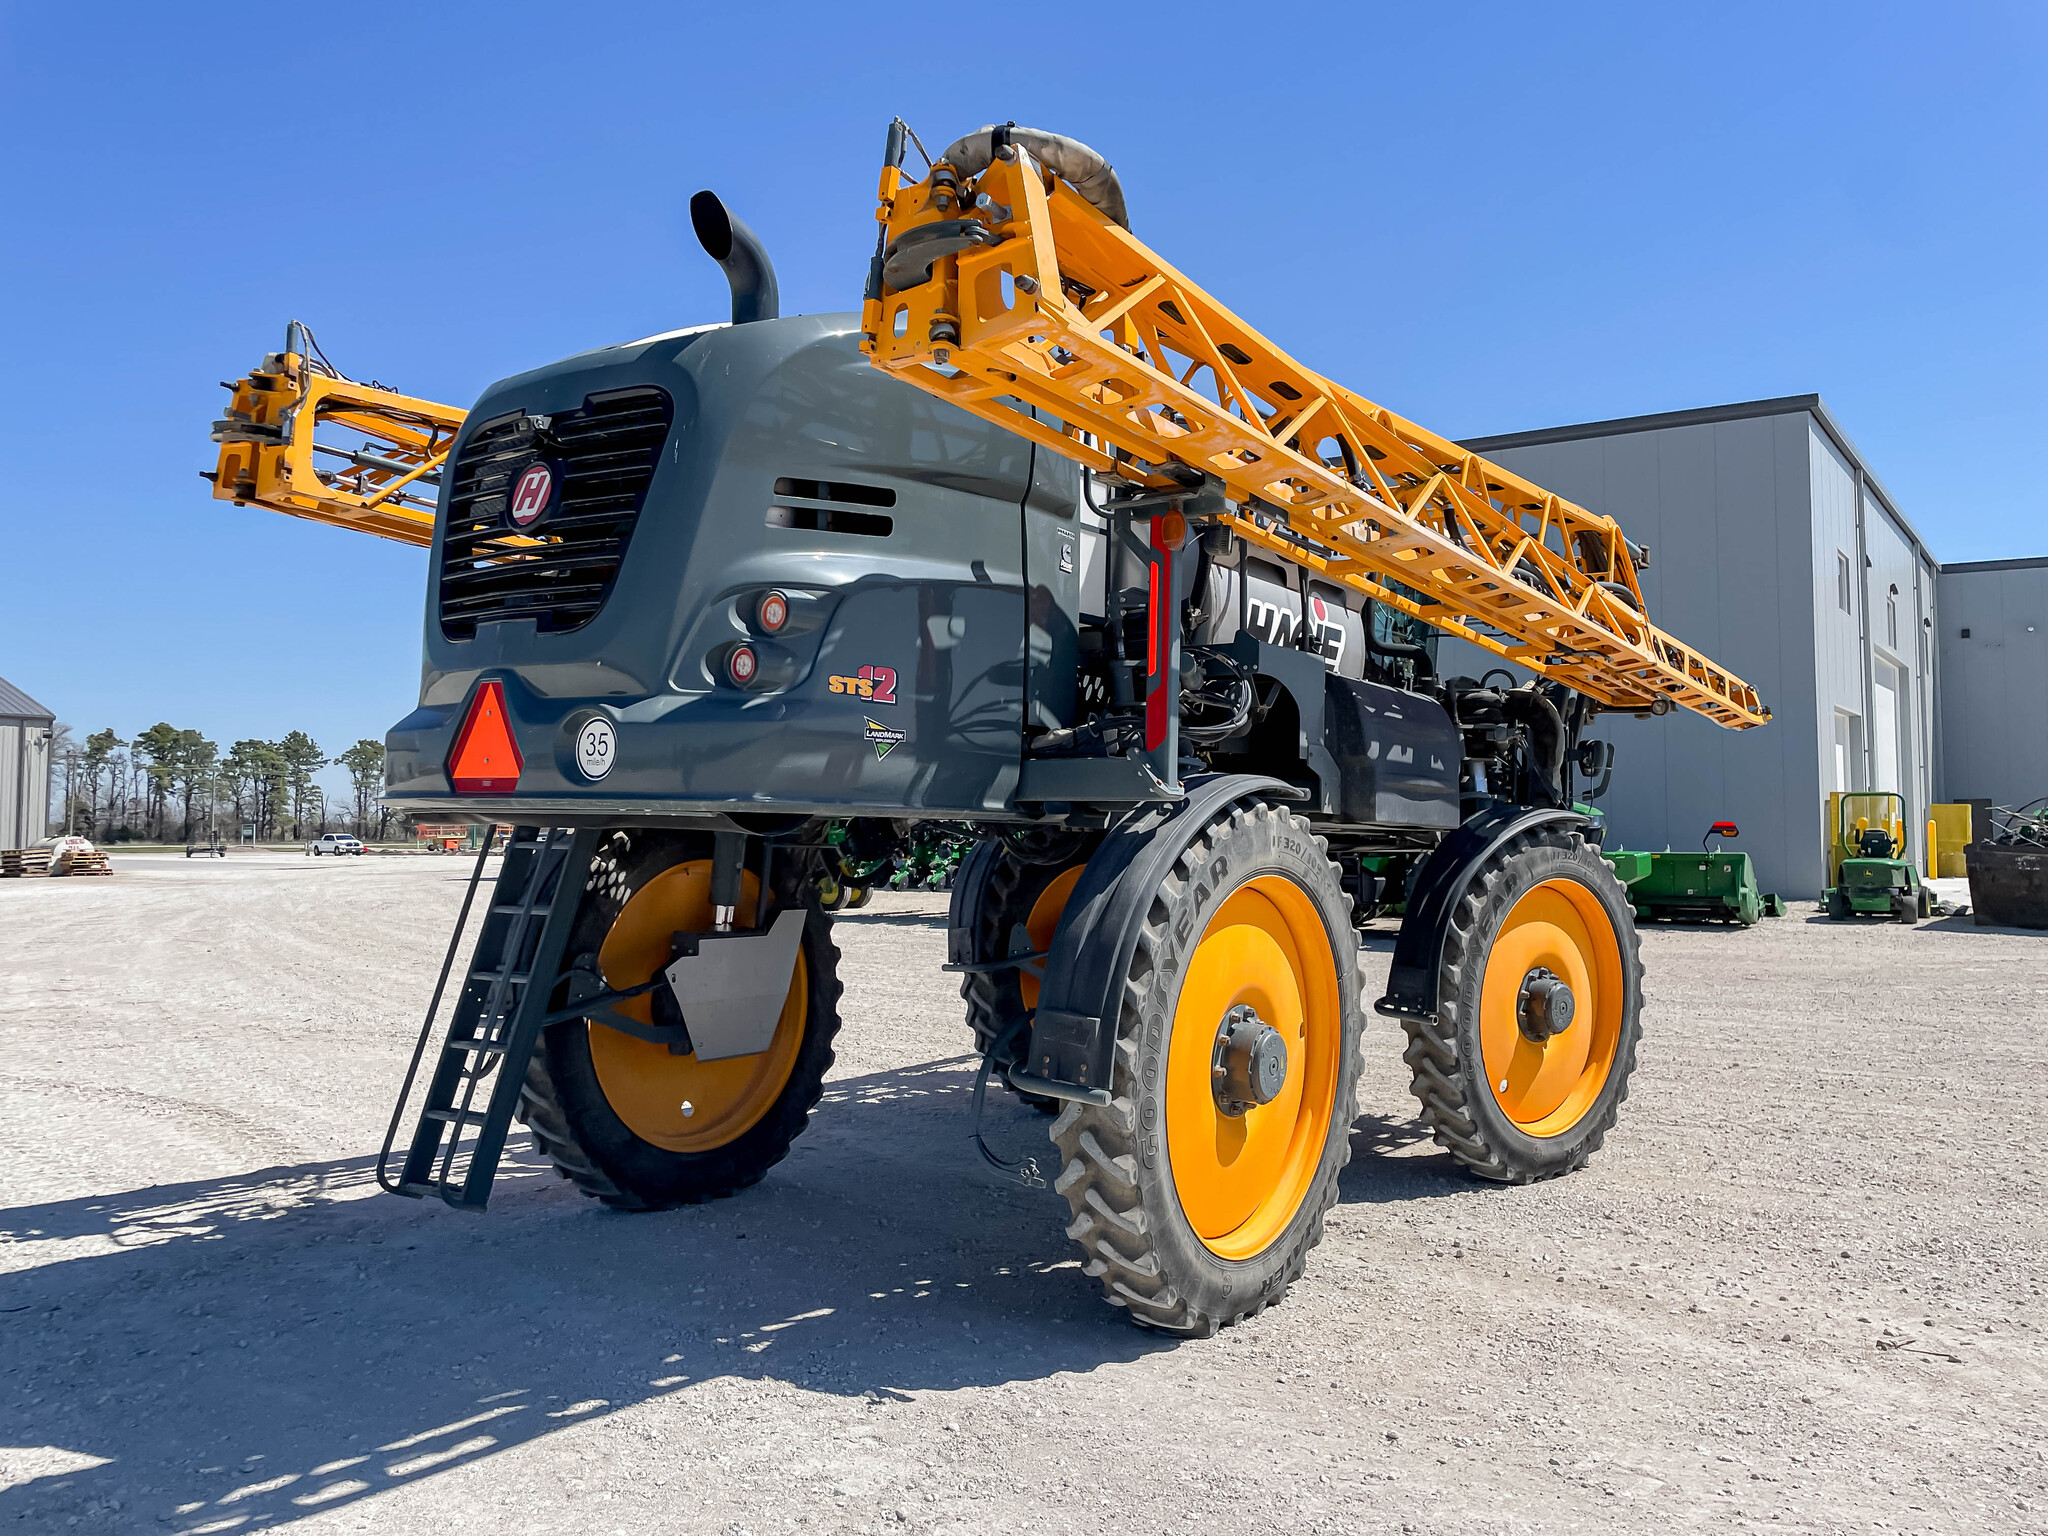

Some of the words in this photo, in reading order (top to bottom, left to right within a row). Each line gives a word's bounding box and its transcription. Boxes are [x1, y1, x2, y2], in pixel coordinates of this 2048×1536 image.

[586, 732, 609, 757] 35
[586, 758, 606, 766] mile/h
[1141, 854, 1229, 1169] GOODYEAR
[1460, 872, 1518, 1081] GOODYEAR
